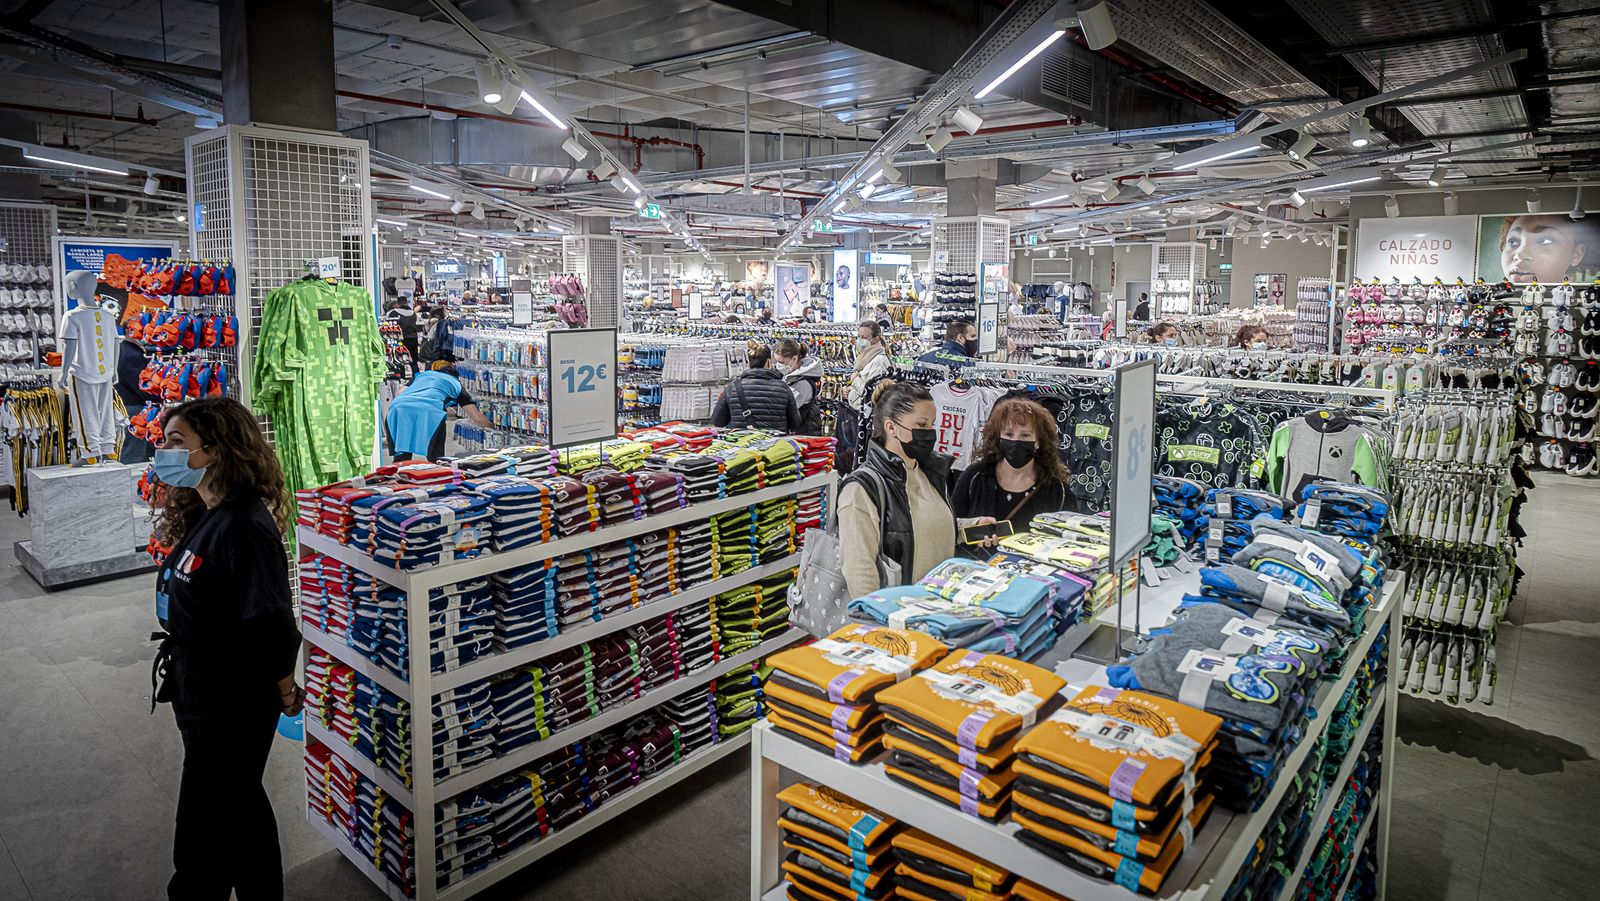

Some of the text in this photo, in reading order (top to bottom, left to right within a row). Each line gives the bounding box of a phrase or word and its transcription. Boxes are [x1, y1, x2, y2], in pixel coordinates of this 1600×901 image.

[1379, 239, 1452, 251] CALZADO
[1390, 250, 1439, 265] NIÑAS
[322, 263, 337, 272] 20€
[982, 320, 996, 333] 16€
[561, 363, 607, 393] 12€
[943, 405, 966, 413] CHICAGO
[941, 412, 965, 430] BU
[939, 429, 962, 447] LL
[1126, 423, 1147, 480] 8€
